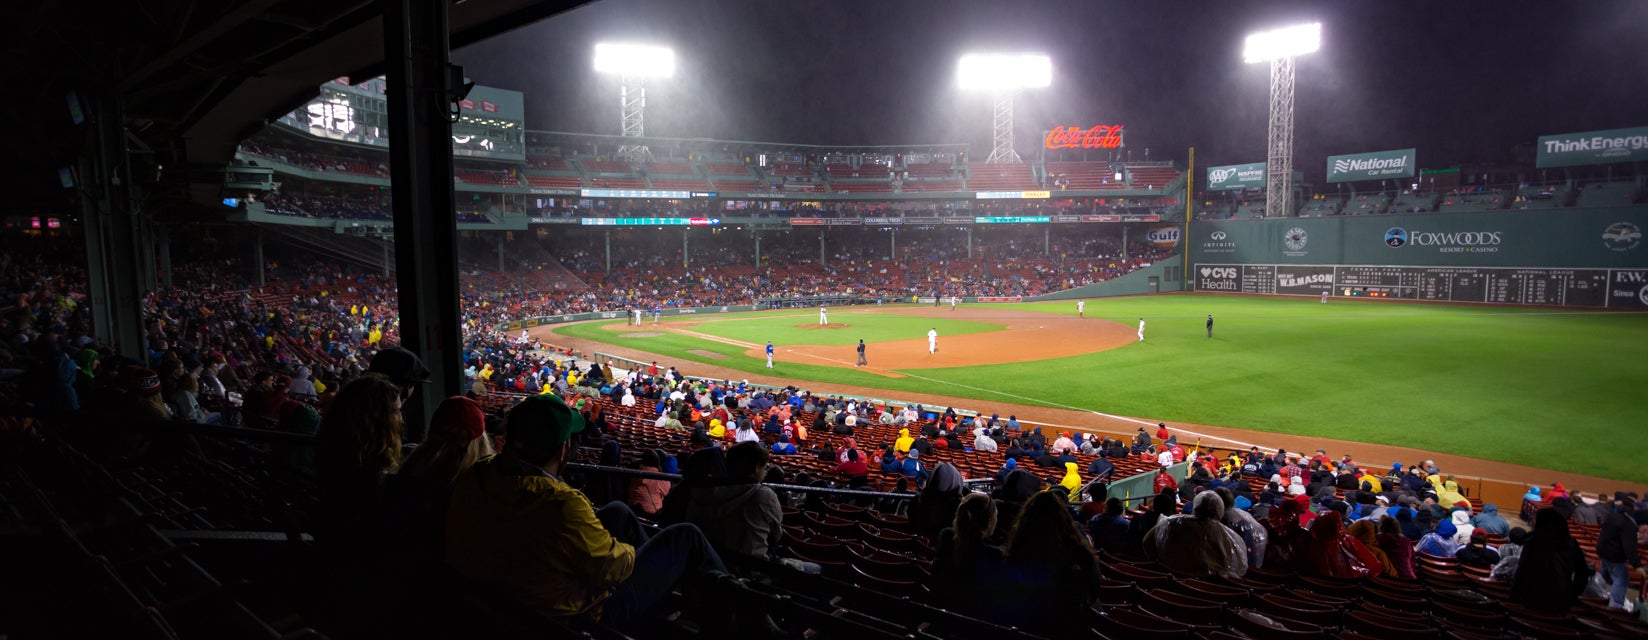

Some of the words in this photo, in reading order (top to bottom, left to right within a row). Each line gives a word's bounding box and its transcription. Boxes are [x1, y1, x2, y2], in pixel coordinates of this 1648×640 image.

[1046, 125, 1123, 149] Coca-Cola
[1349, 155, 1406, 170] National
[1149, 231, 1178, 240] Gulf
[1410, 231, 1501, 245] FOXWOODS
[1212, 267, 1237, 278] CVS
[1201, 279, 1236, 290] Health
